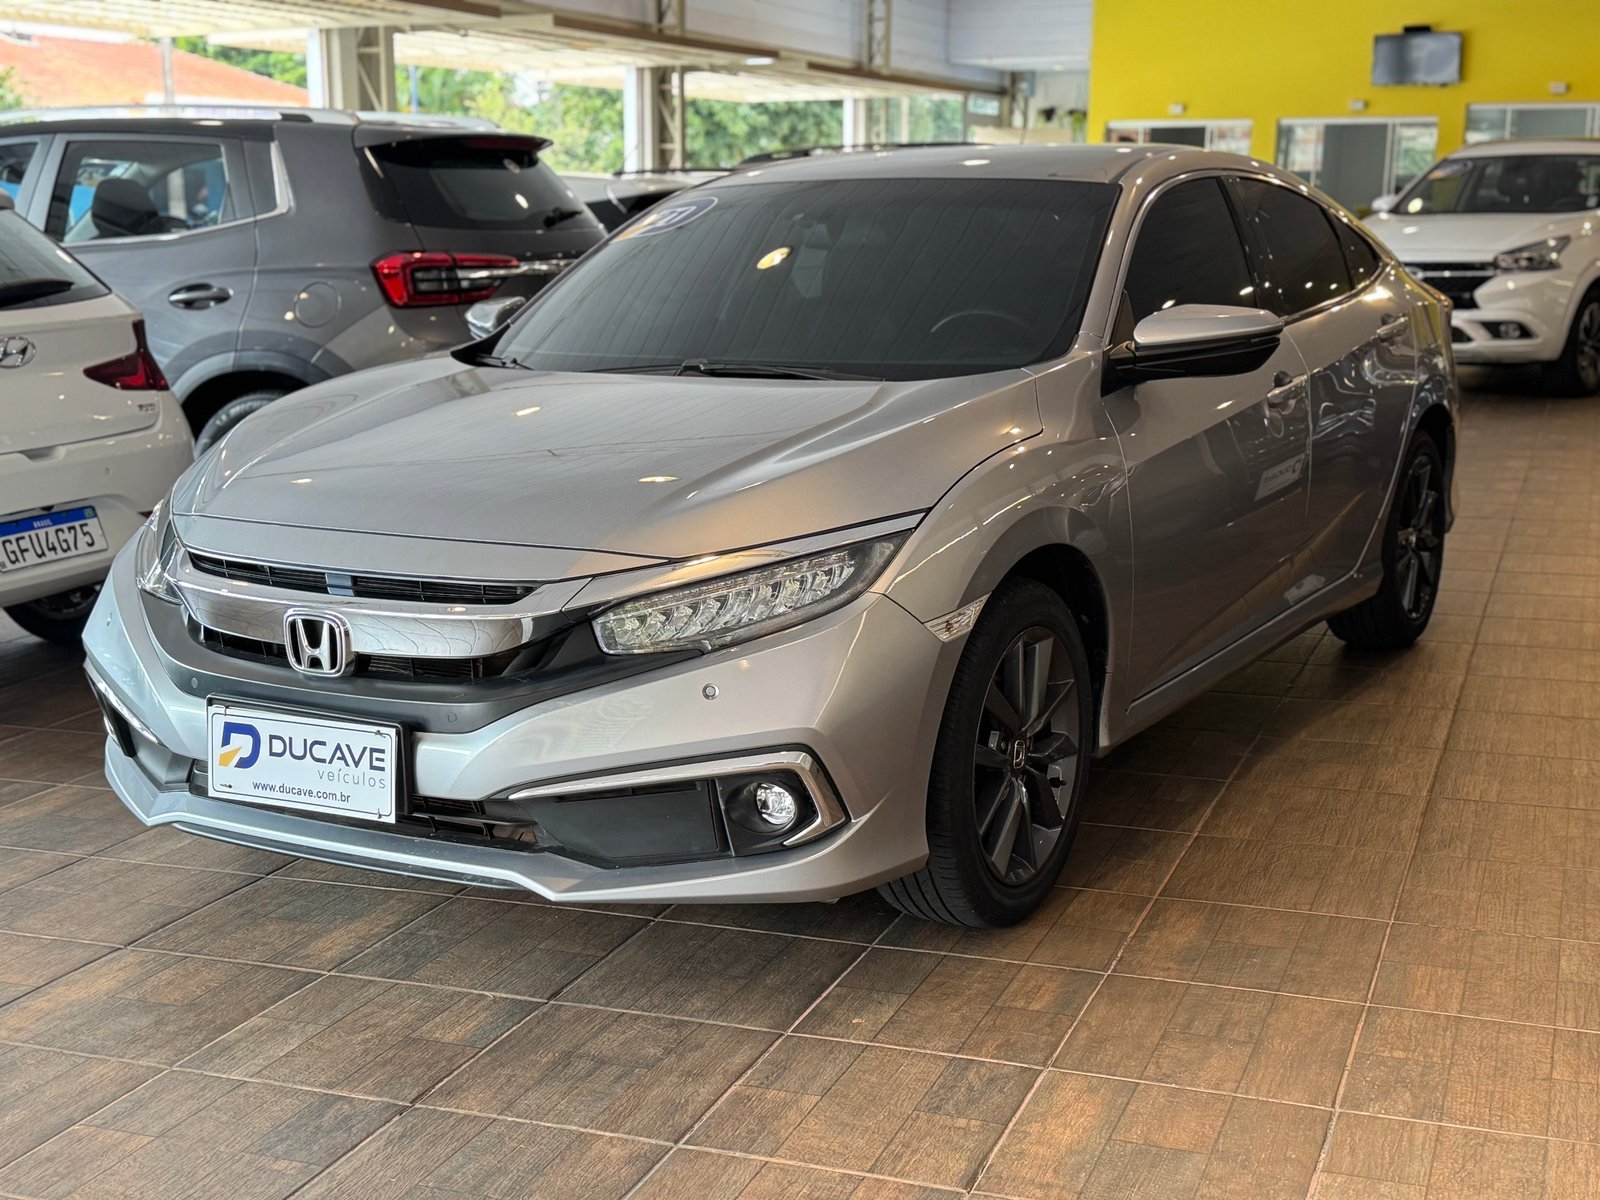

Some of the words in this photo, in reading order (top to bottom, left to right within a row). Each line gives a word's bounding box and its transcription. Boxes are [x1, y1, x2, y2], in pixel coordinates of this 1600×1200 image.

[2, 522, 95, 565] GFU4G75
[268, 734, 386, 772] DUCAVE
[252, 780, 351, 804] www.ducave.com.br
[317, 768, 387, 790] veículos
